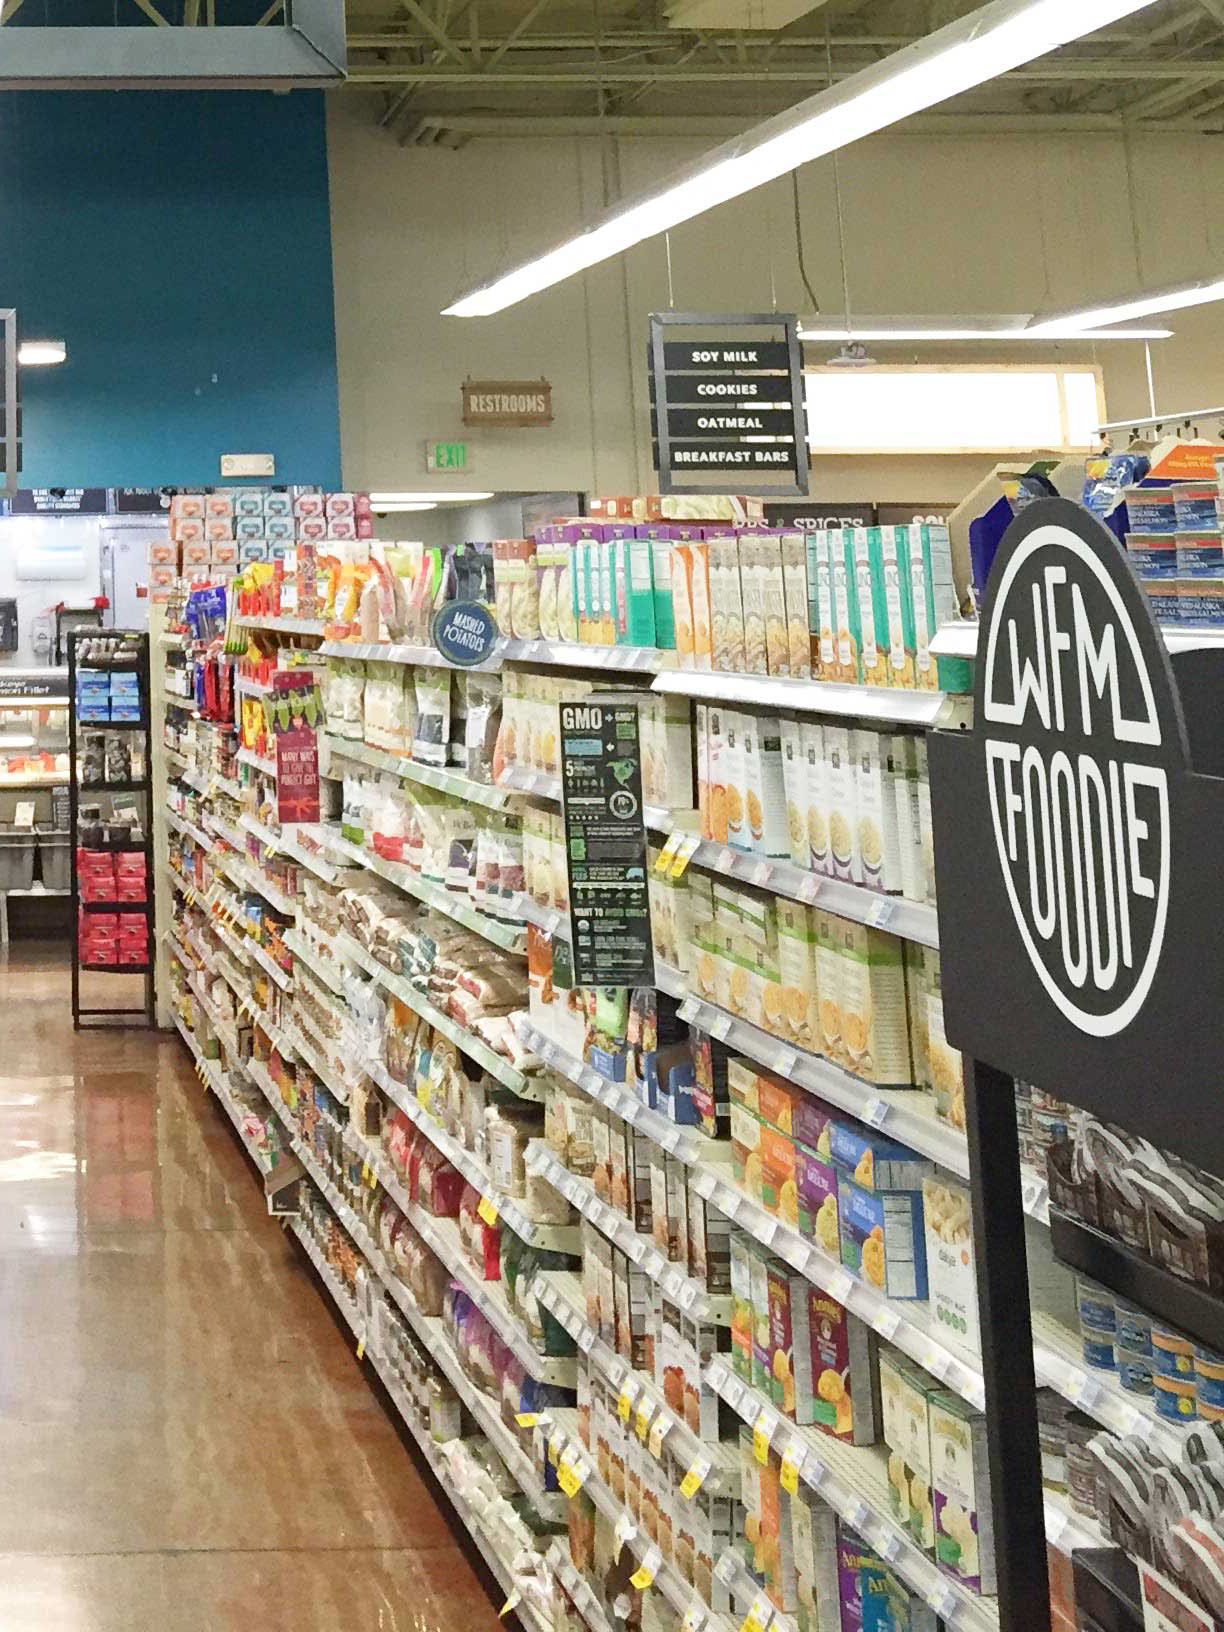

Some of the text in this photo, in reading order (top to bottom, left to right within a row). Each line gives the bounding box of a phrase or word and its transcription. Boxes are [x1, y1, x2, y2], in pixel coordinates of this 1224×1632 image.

[691, 351, 759, 364] SOY MILK
[696, 383, 758, 397] COOKIES
[469, 394, 546, 413] RESTROOMS
[697, 417, 763, 430] OATMEAL
[436, 444, 467, 468] EXIT
[674, 450, 790, 464] BREAKFAST BARS
[452, 611, 486, 635] MASHED
[443, 624, 486, 653] POTATOES
[988, 560, 1148, 744] WFM
[562, 707, 603, 730] GMO
[565, 760, 574, 778] 5
[991, 742, 1164, 1002] FOODIE
